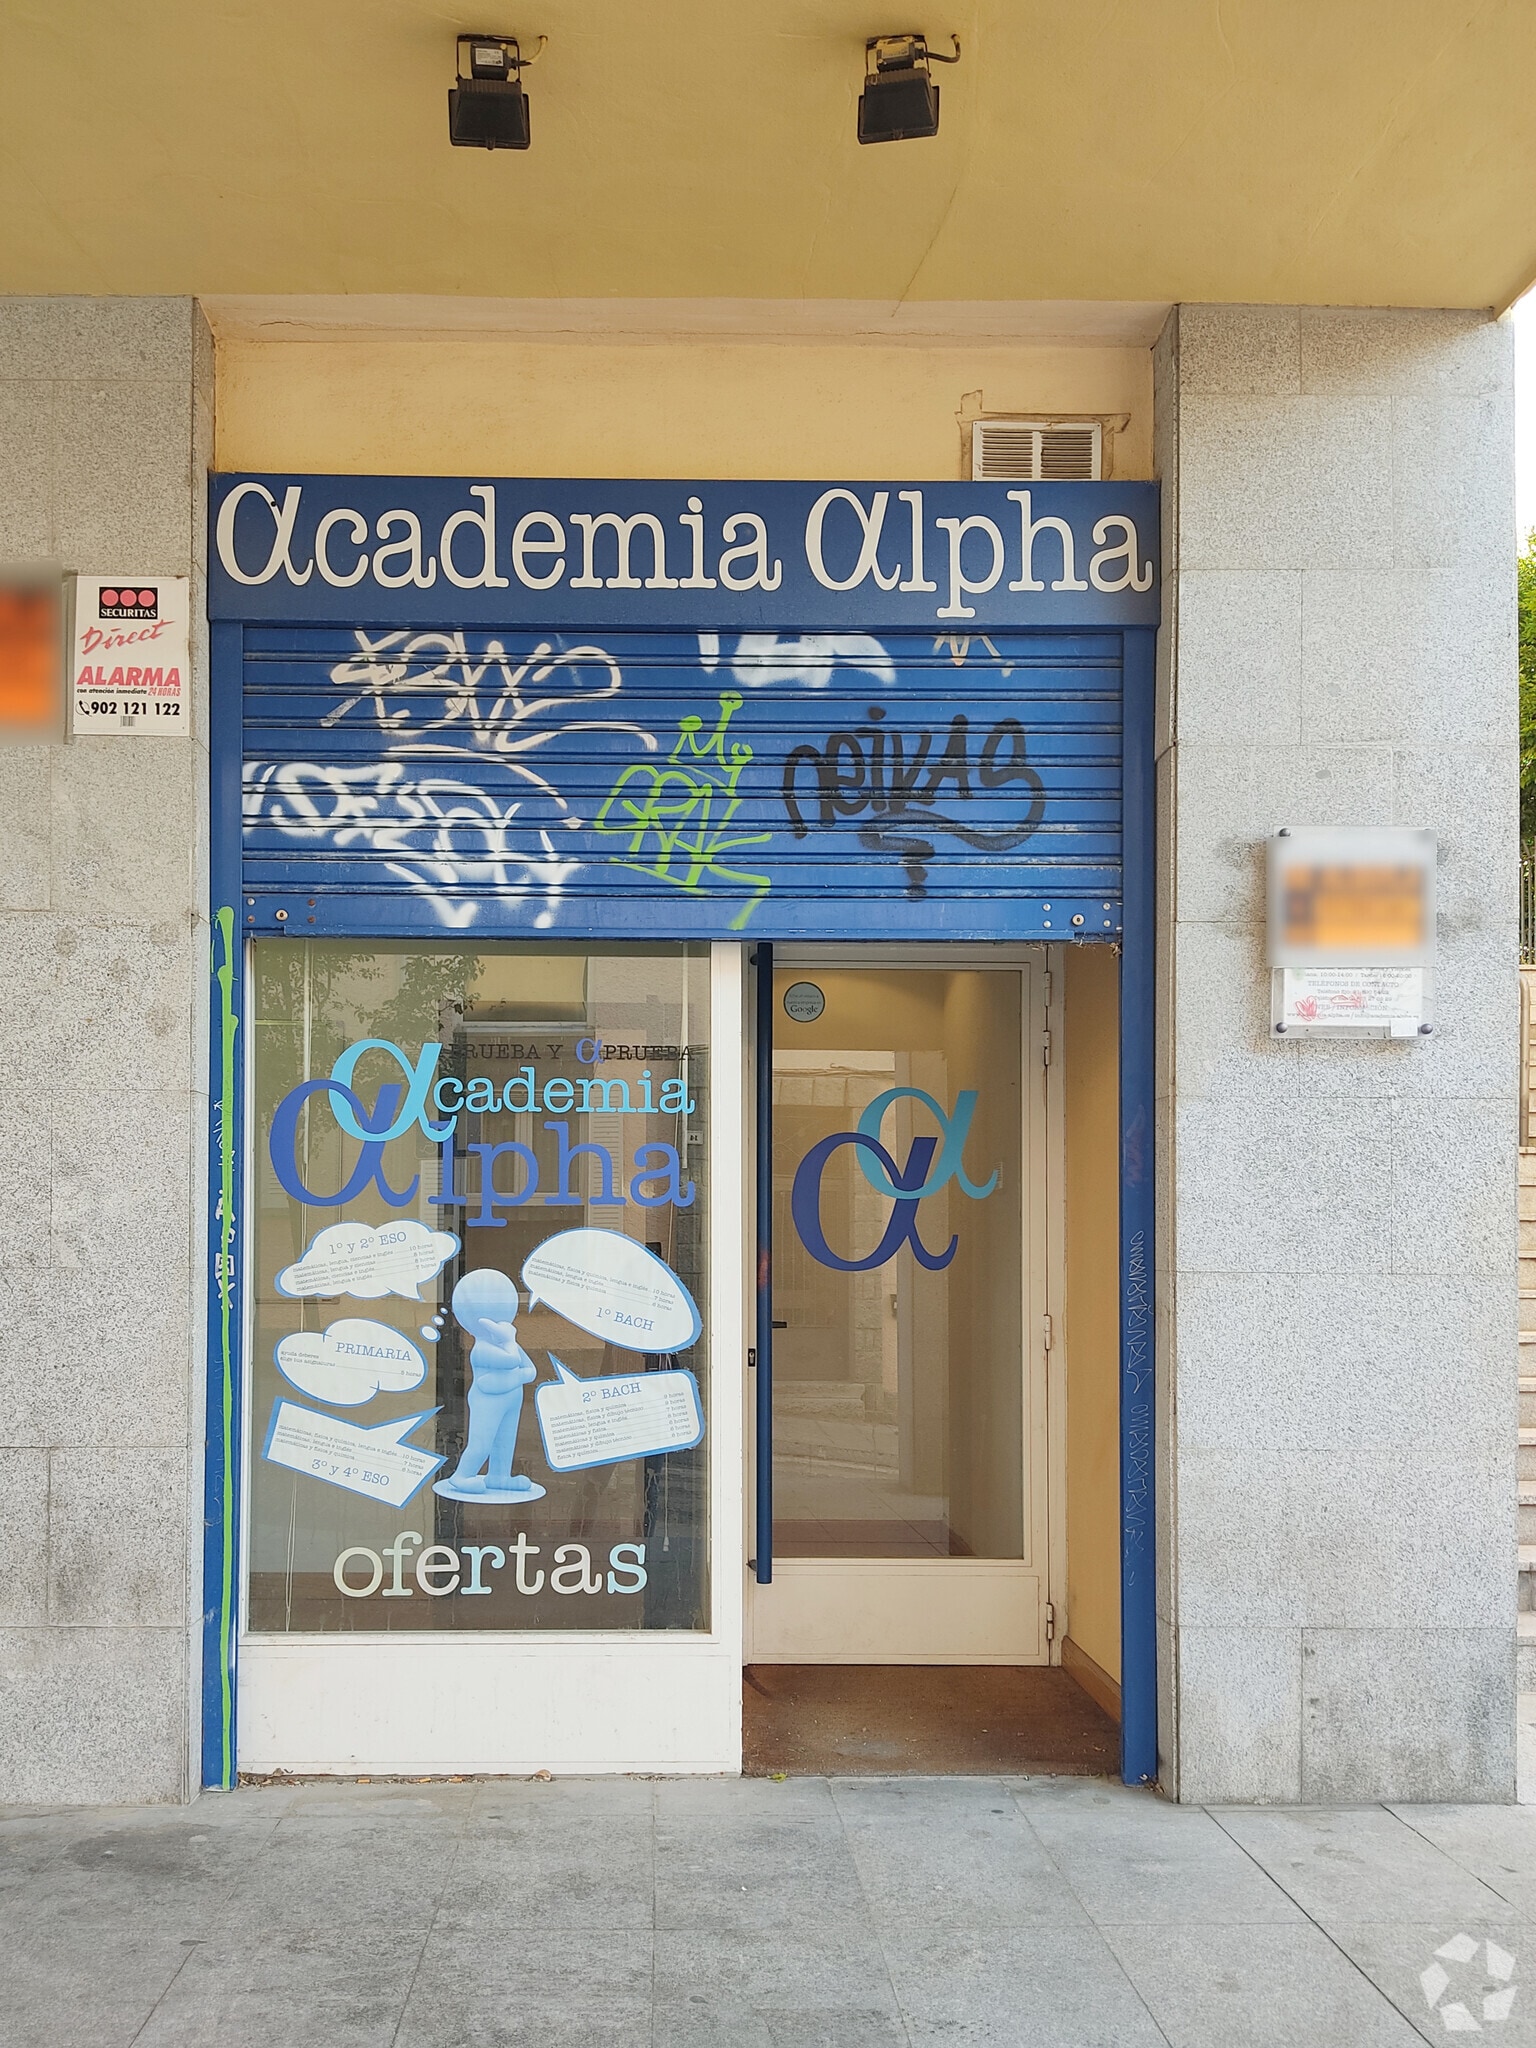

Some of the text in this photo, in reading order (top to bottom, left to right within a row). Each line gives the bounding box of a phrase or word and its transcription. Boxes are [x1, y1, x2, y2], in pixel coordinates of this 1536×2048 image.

[100, 608, 157, 618] SECURITAS
[80, 619, 175, 655] Direct
[76, 666, 181, 687] ALARMA
[148, 687, 156, 696] 24
[157, 688, 181, 697] HORAS
[91, 702, 180, 716] 902 121 122
[790, 1004, 818, 1015] Google
[347, 1243, 356, 1254] y
[378, 1231, 407, 1246] ESO
[613, 1310, 655, 1331] BACH
[335, 1341, 411, 1361] PRIMARIA
[601, 1382, 642, 1399] BACH
[328, 1465, 339, 1476] y
[361, 1470, 390, 1486] ESO
[333, 1530, 648, 1598] ofertas
